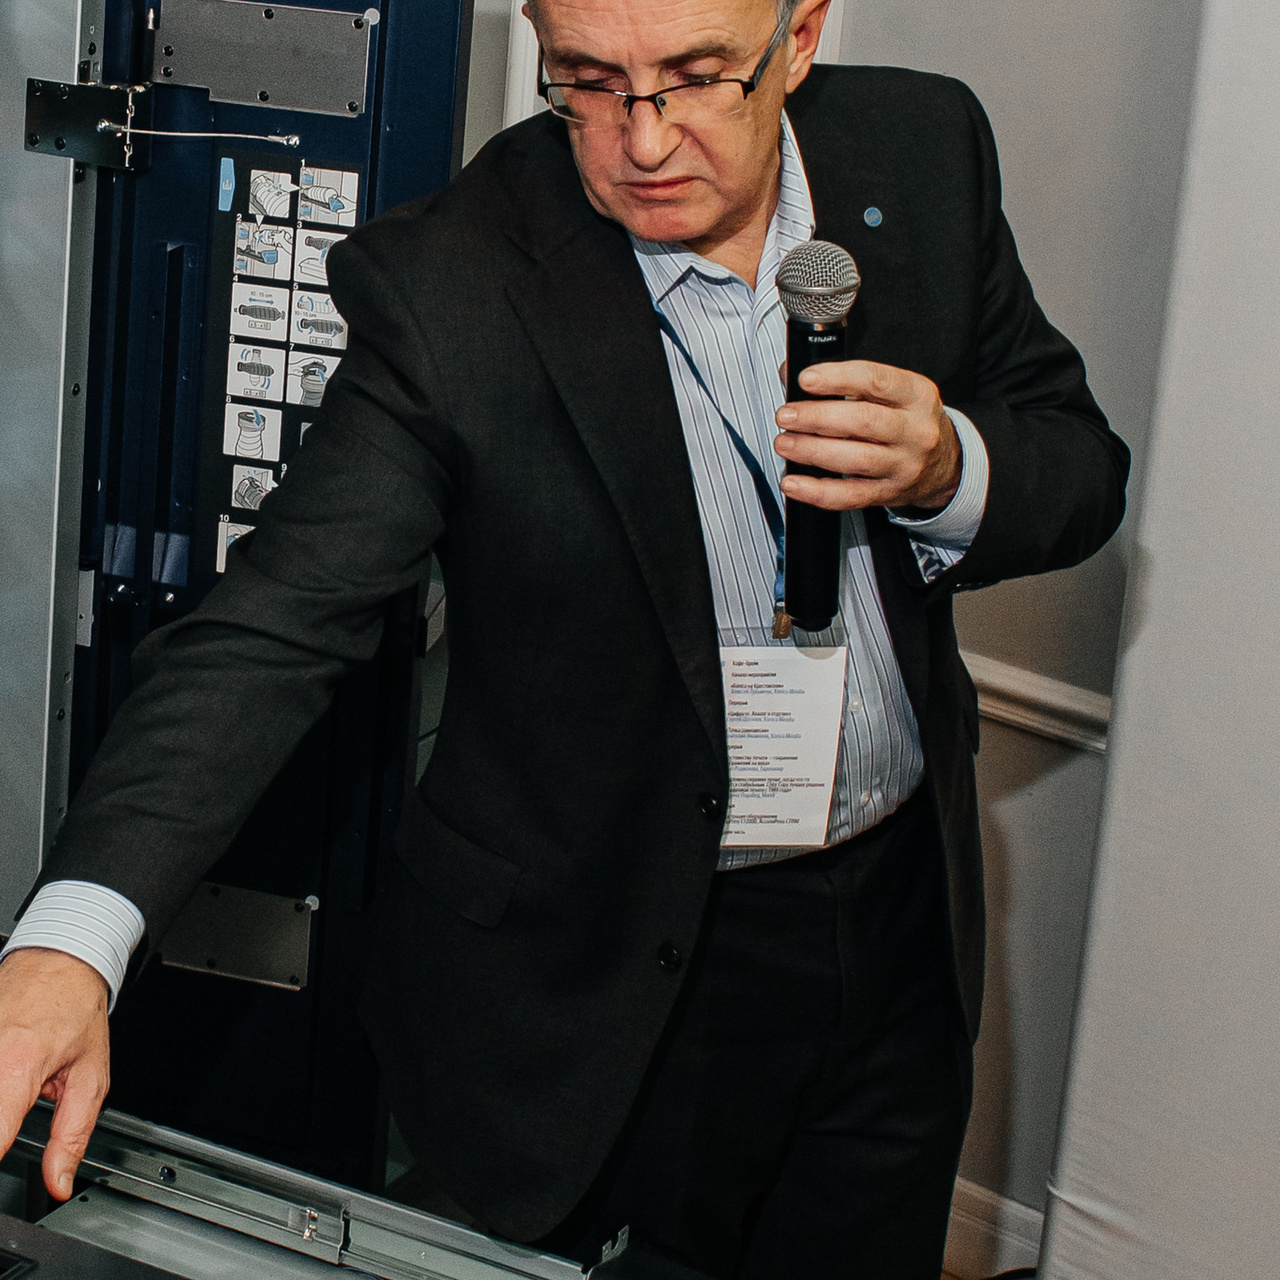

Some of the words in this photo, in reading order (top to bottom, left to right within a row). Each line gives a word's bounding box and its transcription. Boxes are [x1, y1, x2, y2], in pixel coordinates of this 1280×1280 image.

[301, 159, 306, 167] 1
[236, 213, 242, 221] 2
[297, 221, 303, 229] 3
[293, 283, 299, 291] 5
[229, 335, 235, 343] 6
[226, 395, 232, 403] 8
[281, 463, 288, 471] 9
[220, 514, 230, 522] 10
